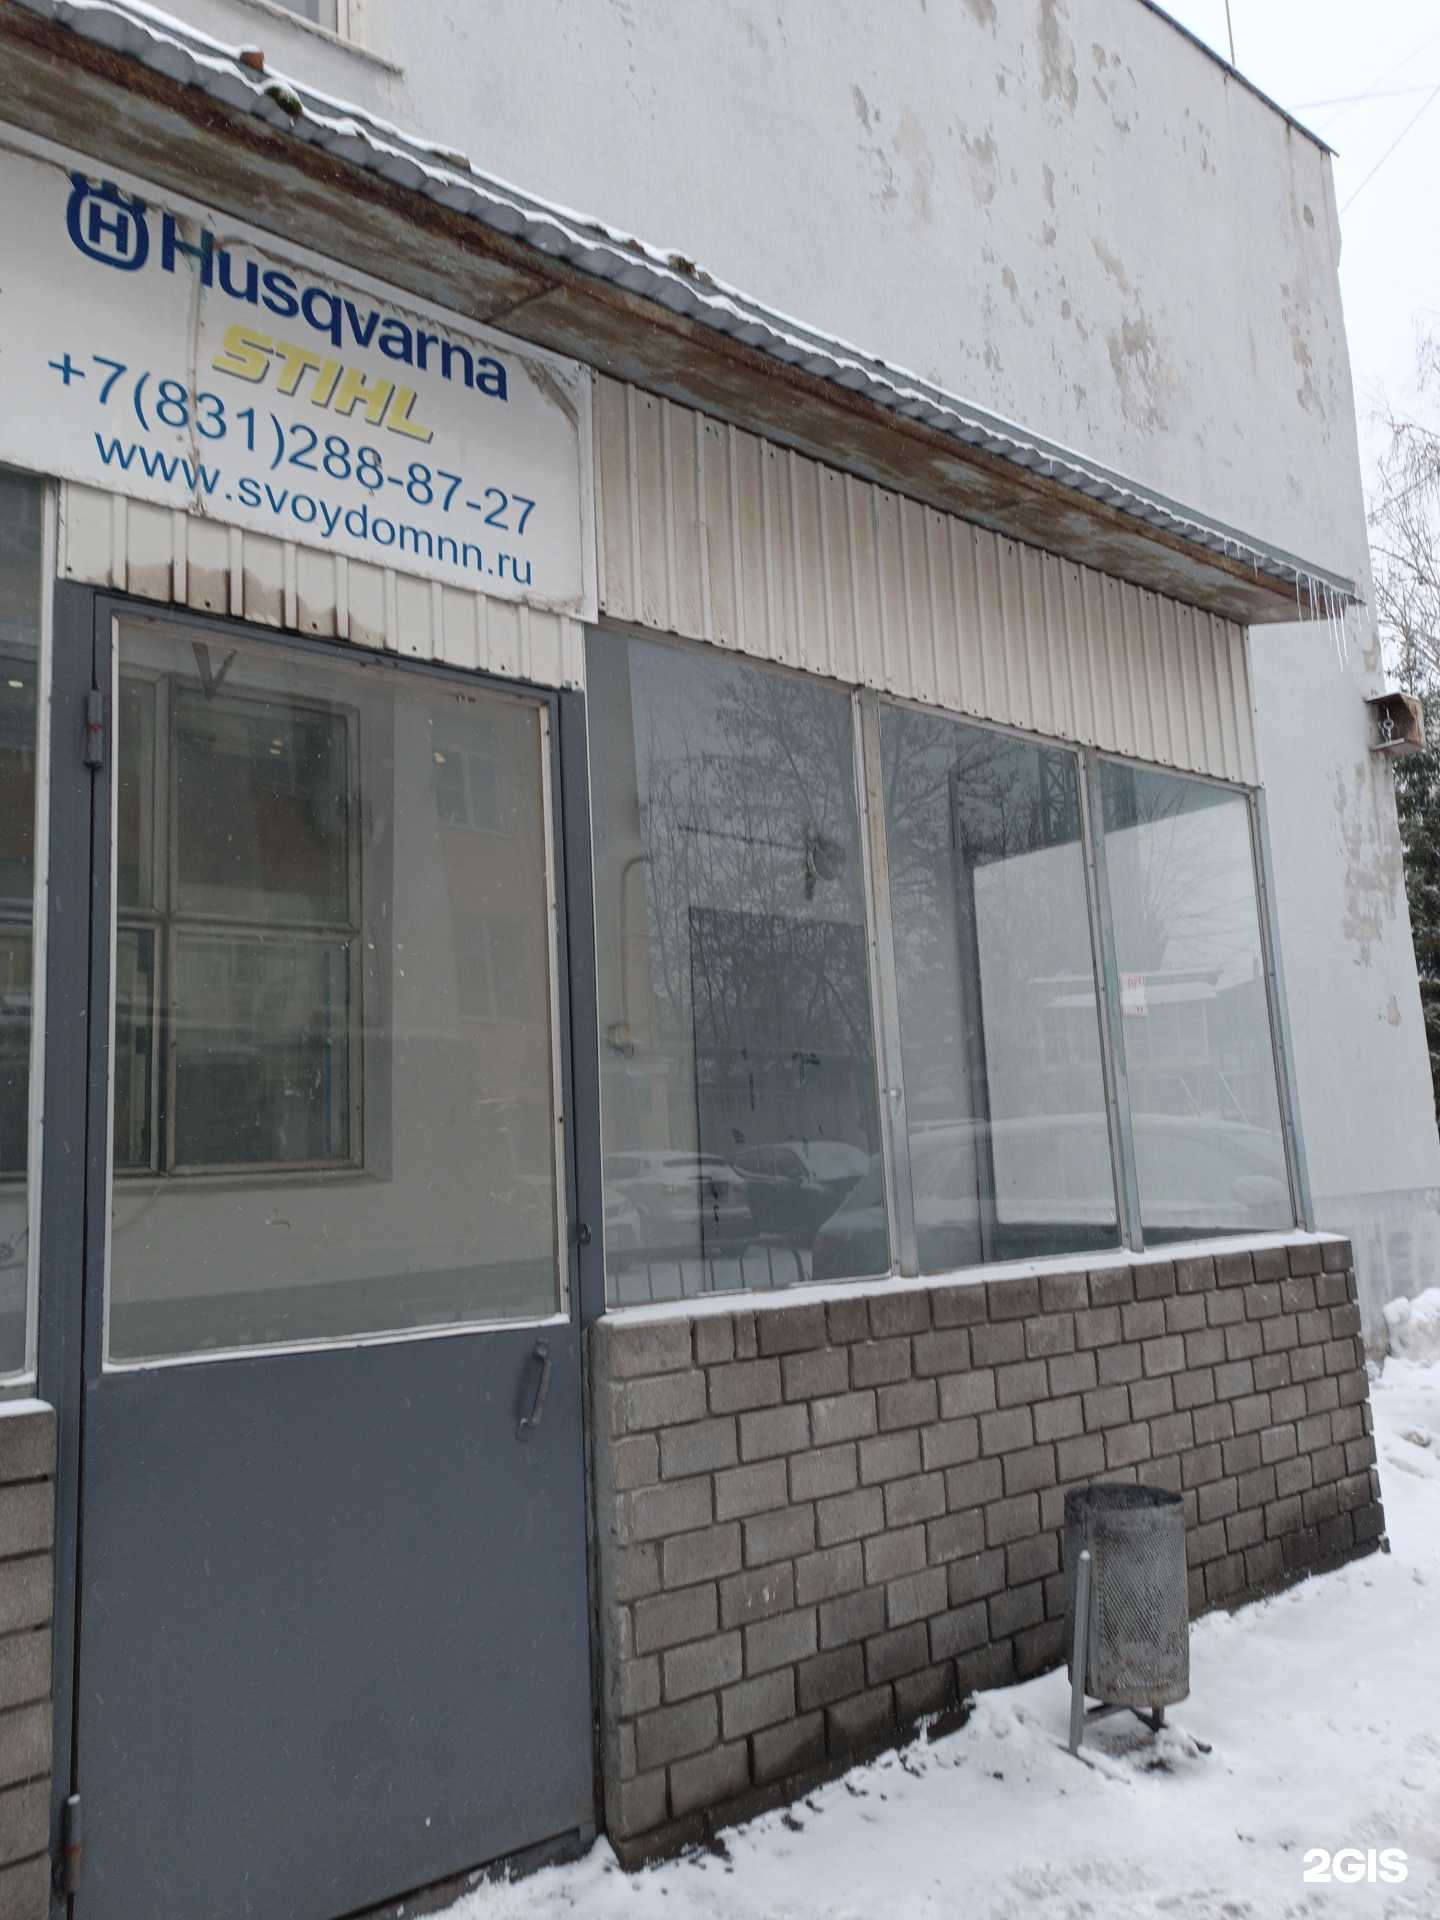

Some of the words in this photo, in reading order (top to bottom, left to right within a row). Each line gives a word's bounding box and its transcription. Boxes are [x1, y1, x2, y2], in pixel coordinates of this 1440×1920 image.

[161, 213, 508, 401] Husqvarna
[212, 325, 433, 444] STIHL
[47, 353, 536, 536] +7(831)288-87-27
[94, 432, 533, 585] www.svoydomnn.ru
